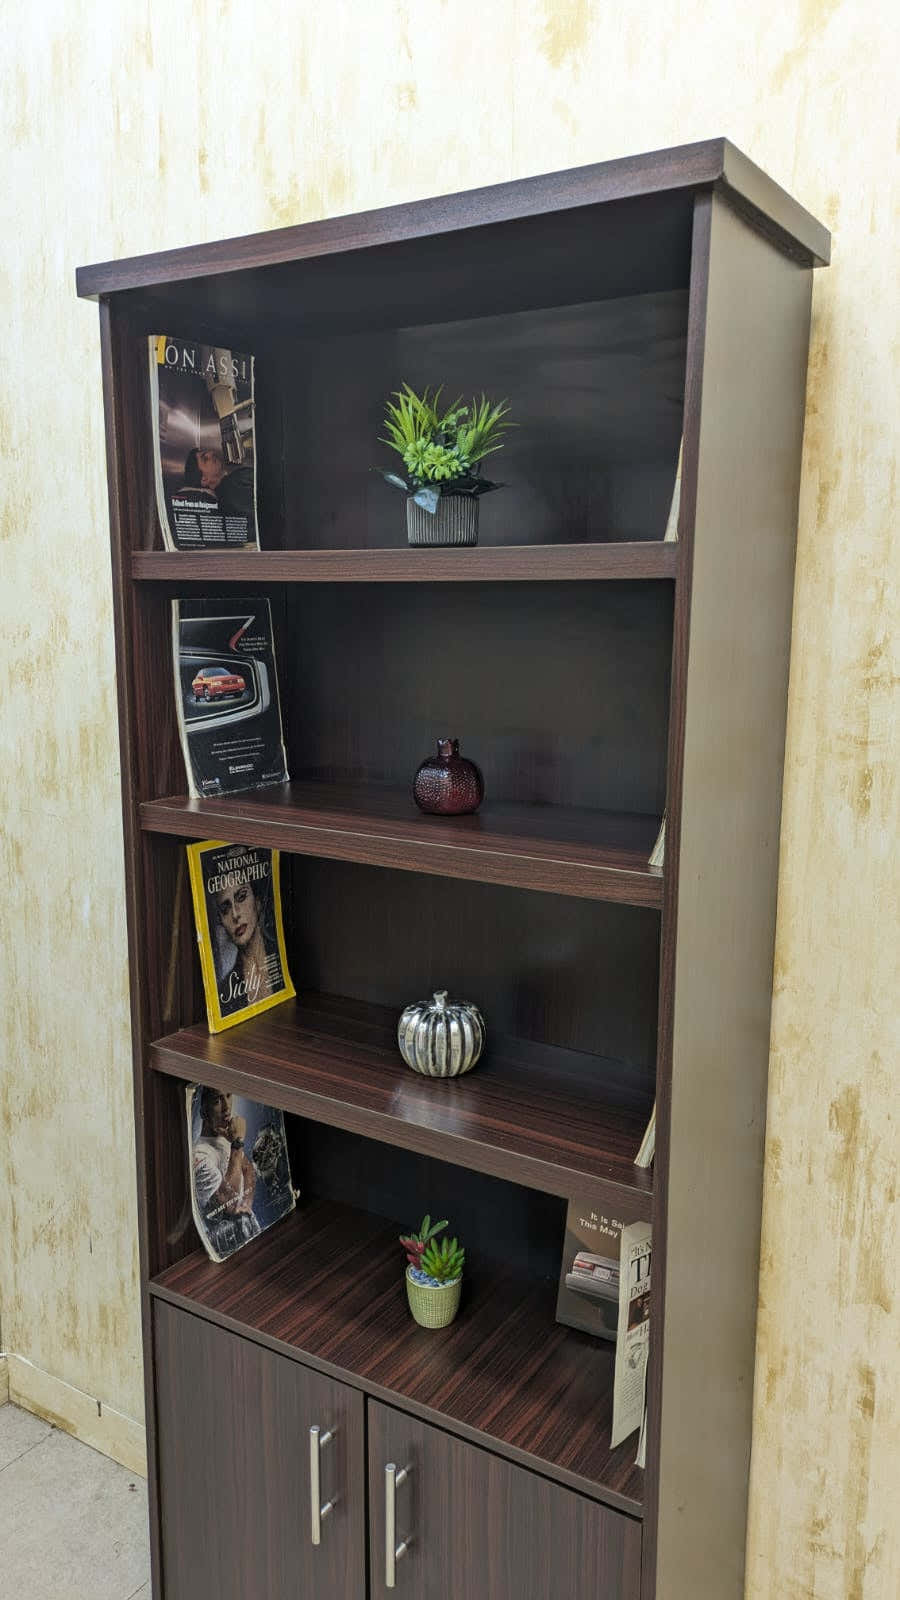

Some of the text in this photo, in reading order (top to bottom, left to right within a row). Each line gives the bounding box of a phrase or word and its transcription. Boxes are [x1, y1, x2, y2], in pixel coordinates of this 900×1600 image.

[165, 345, 196, 368] ON
[218, 852, 260, 874] NATIONAL
[207, 861, 269, 894] GEOGRAPHIC
[220, 962, 261, 1004] Sicily
[579, 1218, 618, 1238] This May
[590, 1212, 598, 1221] It
[600, 1216, 608, 1224] Is
